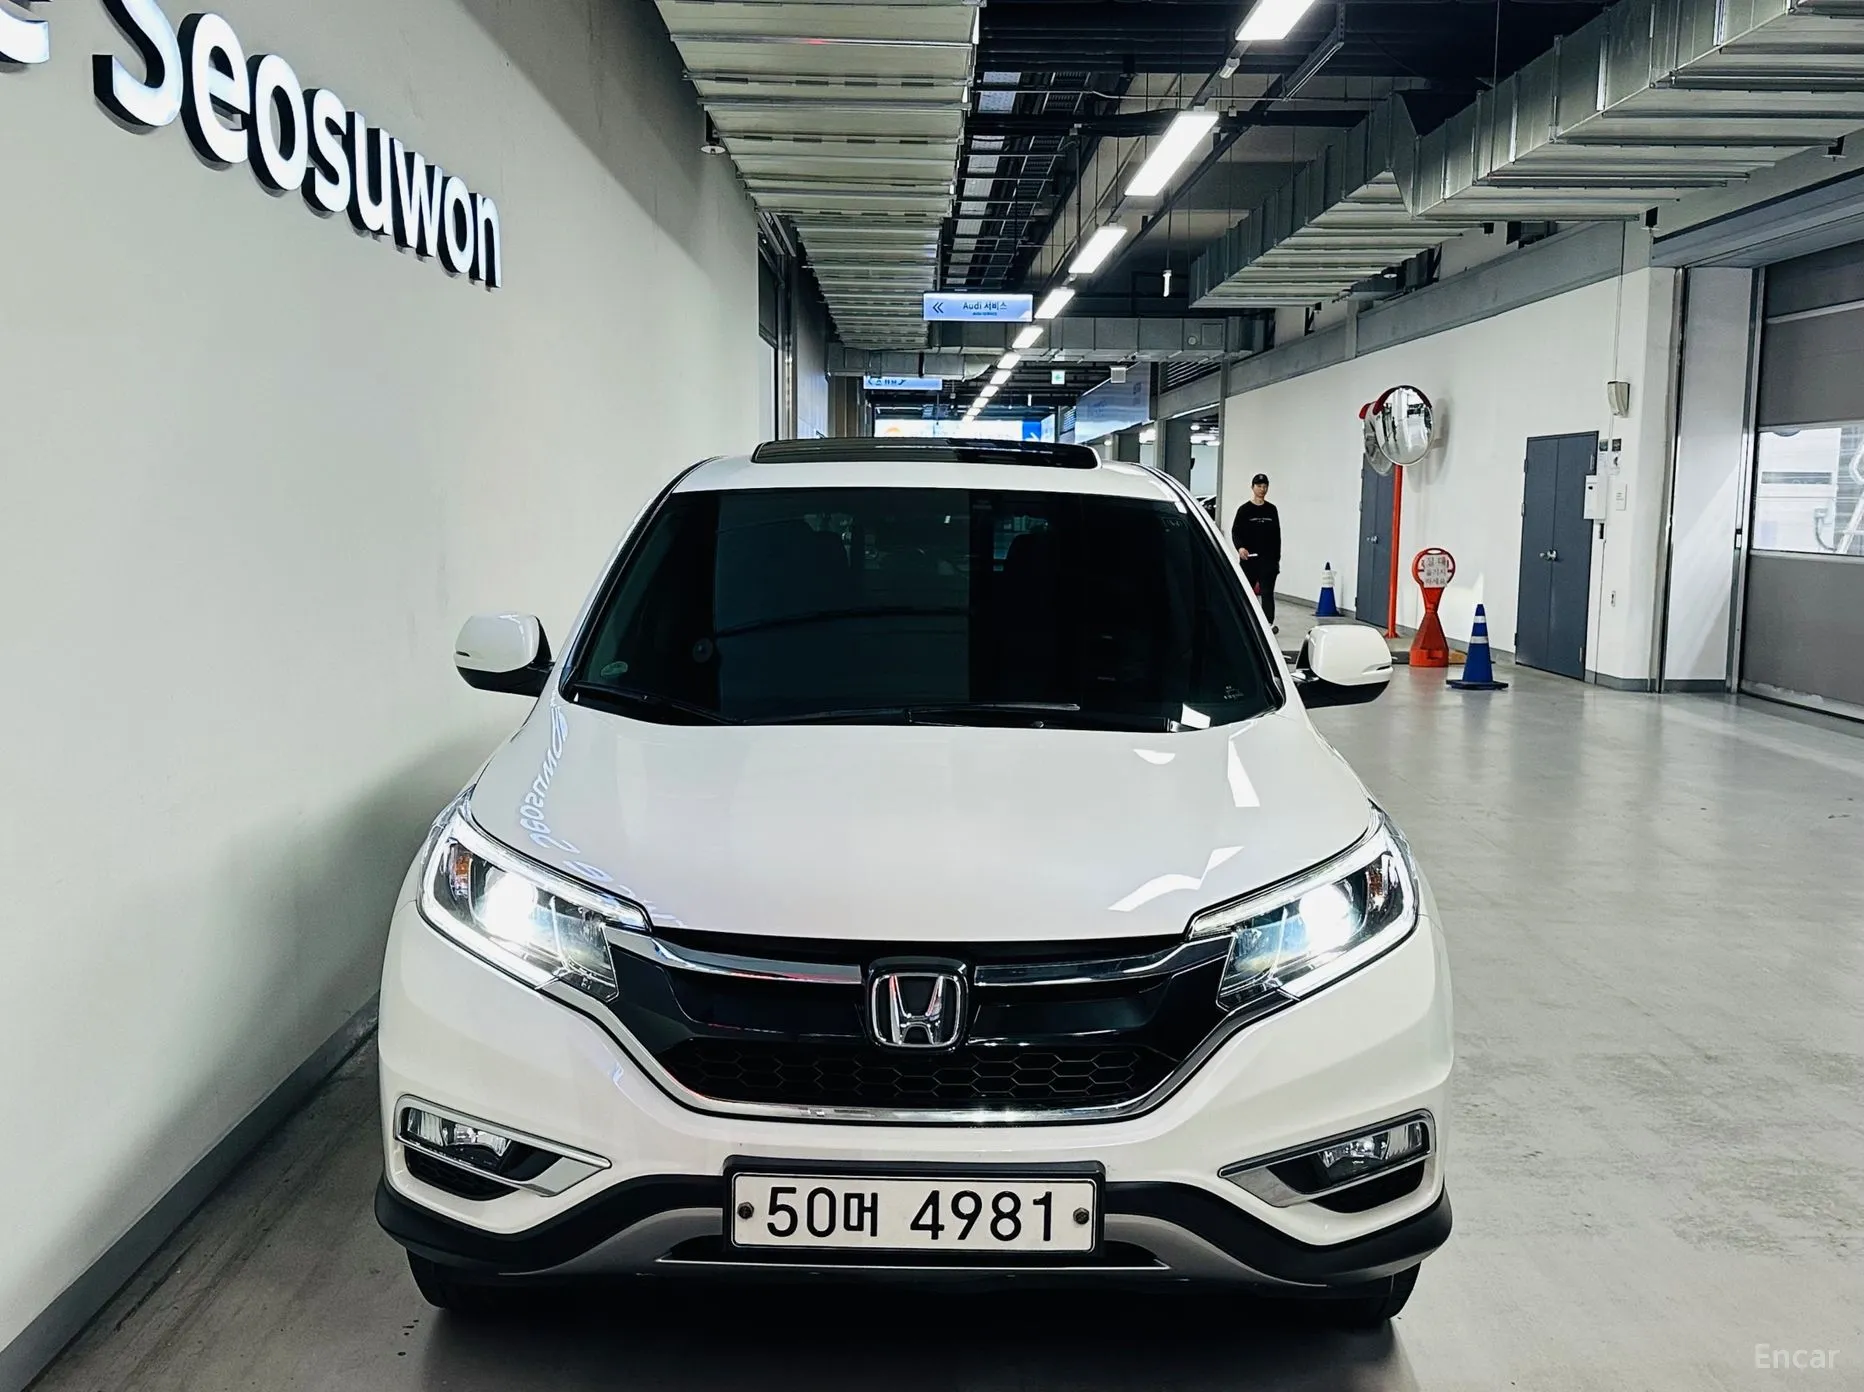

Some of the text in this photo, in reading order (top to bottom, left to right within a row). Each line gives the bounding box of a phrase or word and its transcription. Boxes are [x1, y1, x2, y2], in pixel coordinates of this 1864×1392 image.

[92, 0, 503, 289] Seosuwon
[963, 301, 1007, 311] Audi 서비스
[767, 1186, 1054, 1242] 50머 4981
